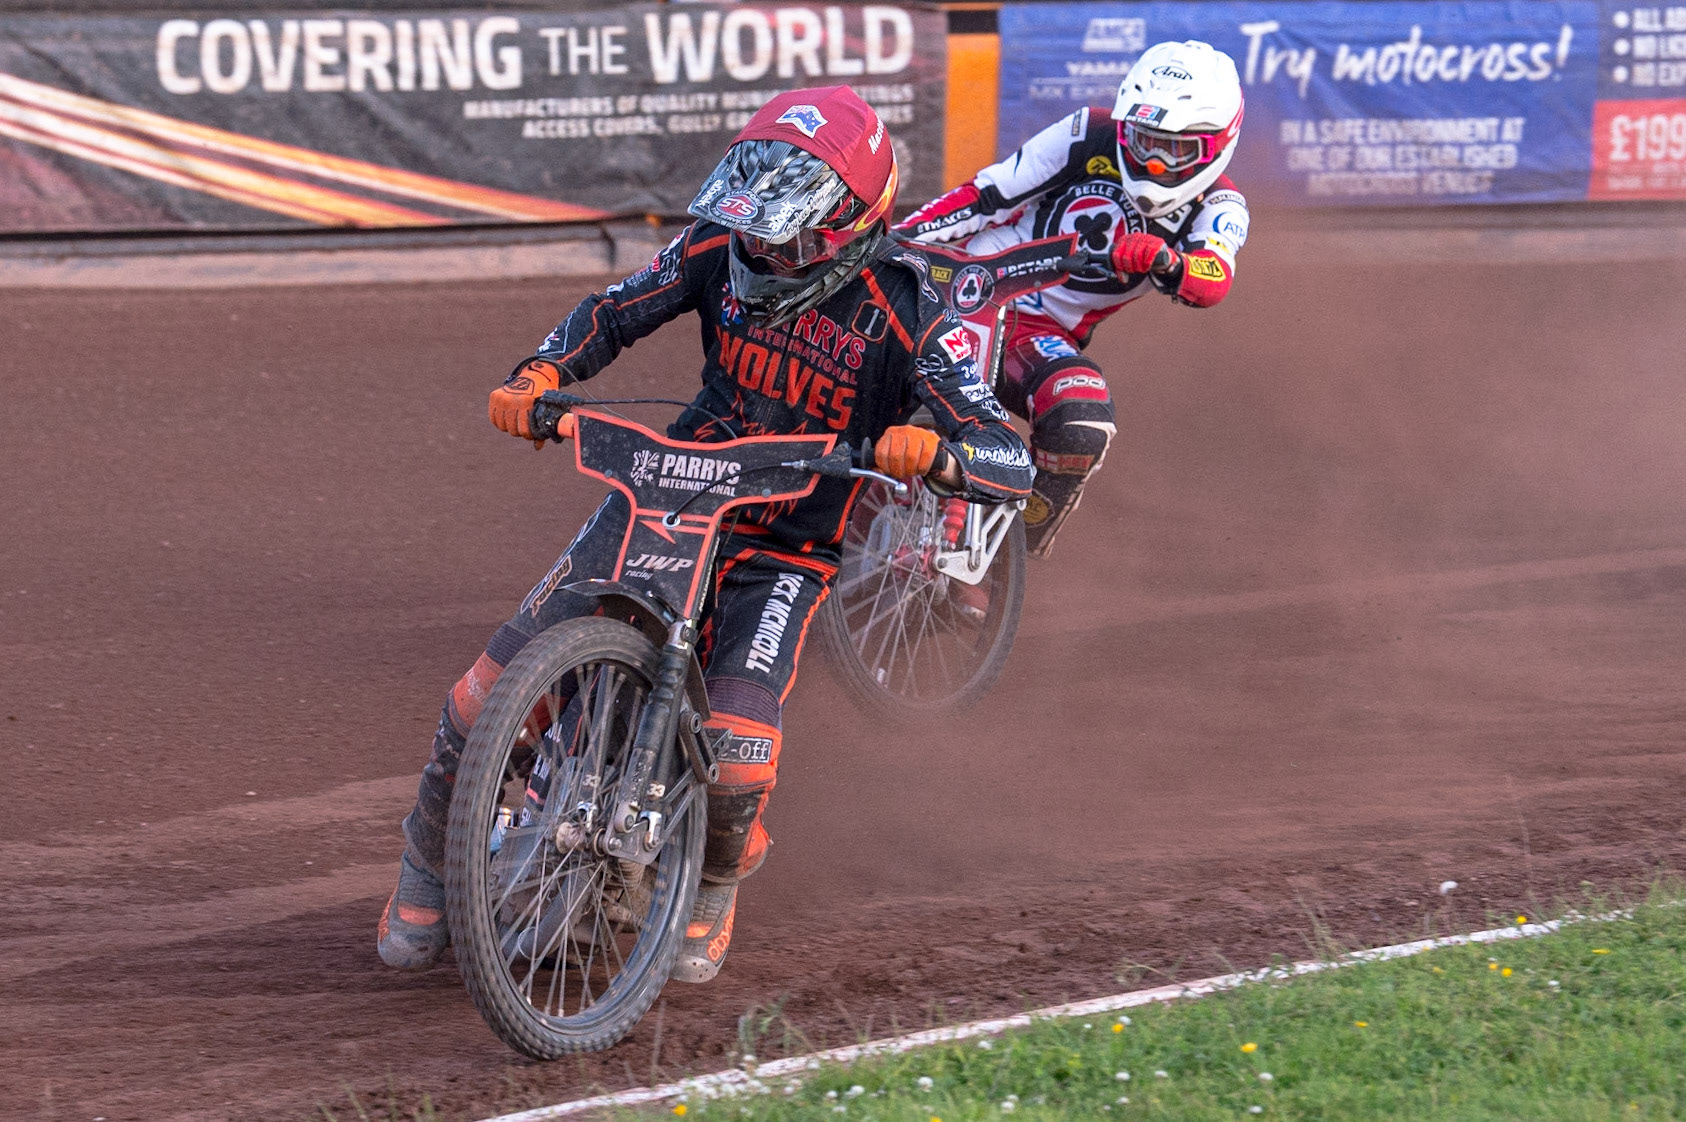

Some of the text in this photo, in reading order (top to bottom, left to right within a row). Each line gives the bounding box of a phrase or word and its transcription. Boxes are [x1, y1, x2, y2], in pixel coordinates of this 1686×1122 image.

[157, 6, 914, 94] COVERING THE WORLD
[1240, 20, 1574, 99] Try motocross!
[1065, 61, 1133, 75] YAMA
[522, 118, 590, 138] ACCESS
[716, 197, 756, 216] STS
[1075, 185, 1115, 197] BELLE
[782, 308, 866, 370] RRYS
[715, 325, 857, 431] WOLVES
[661, 453, 742, 485] PARRYS
[626, 553, 694, 572] JWP
[745, 598, 792, 674] MCNICOLL
